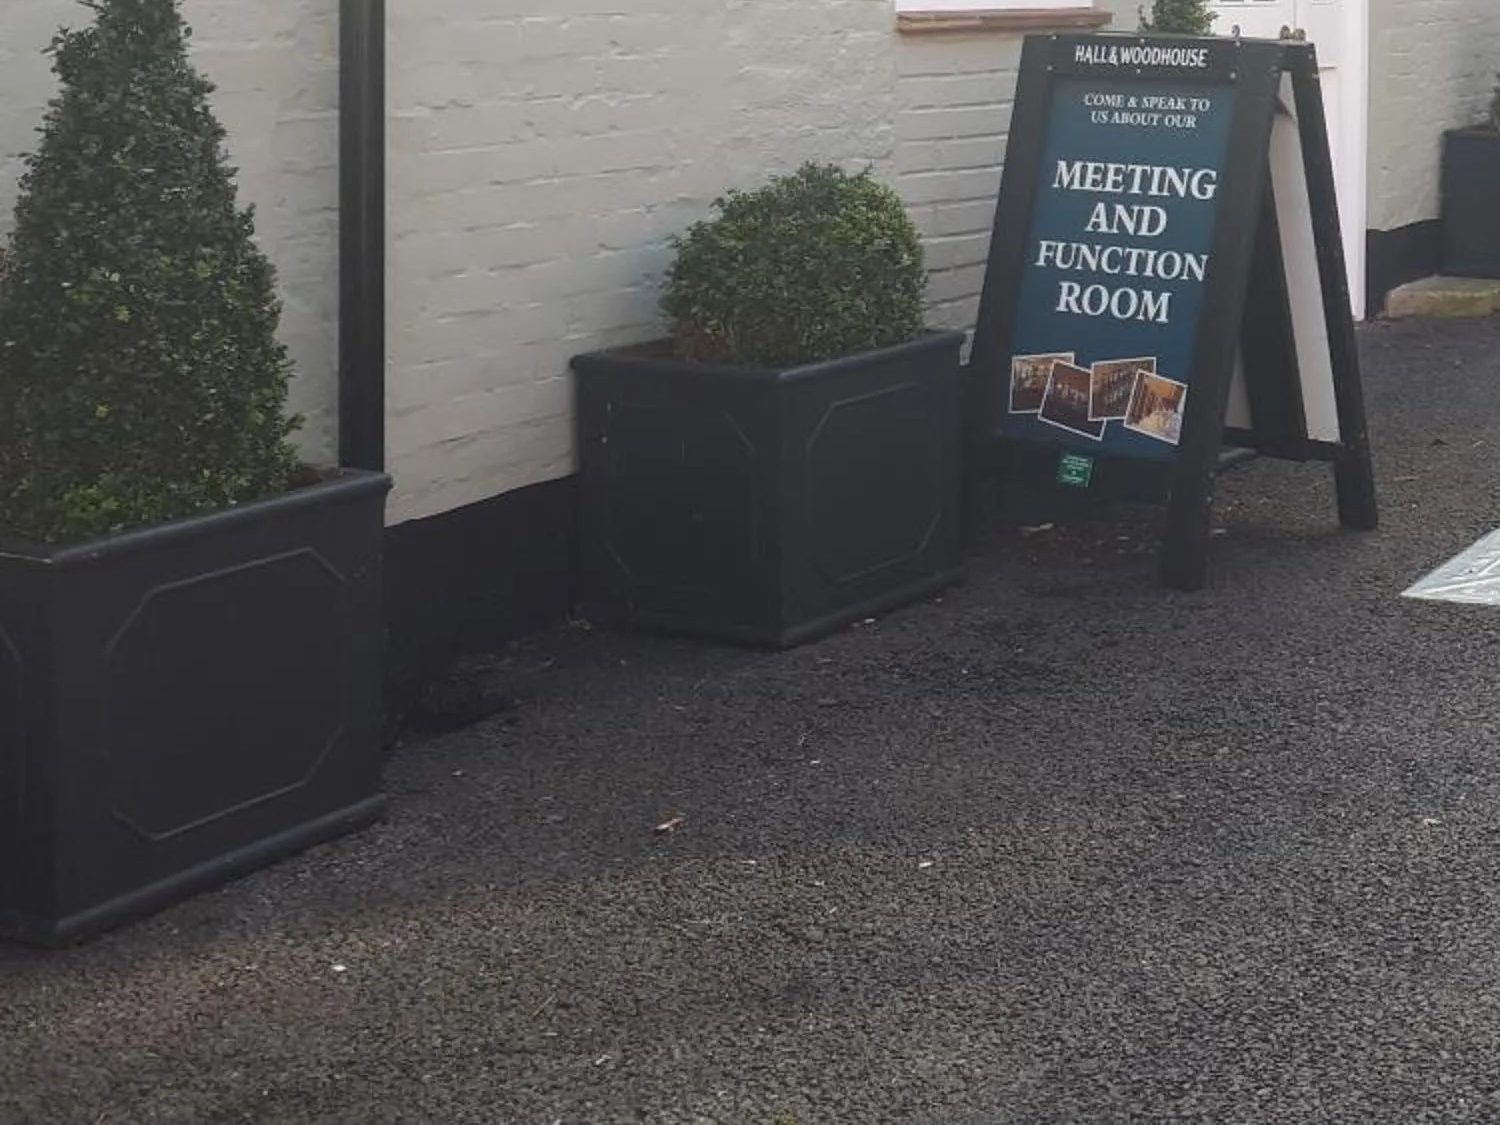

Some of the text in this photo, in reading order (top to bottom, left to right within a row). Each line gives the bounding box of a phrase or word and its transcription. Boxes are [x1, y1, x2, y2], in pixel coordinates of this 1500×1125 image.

[1084, 92, 1211, 112] COME & SPEAK TO
[1091, 110, 1197, 128] US ABOUT OUR
[1052, 159, 1217, 200] MEETING
[1084, 202, 1167, 236] AND
[1034, 240, 1209, 282] FUNCTION
[1055, 280, 1172, 324] ROOM
